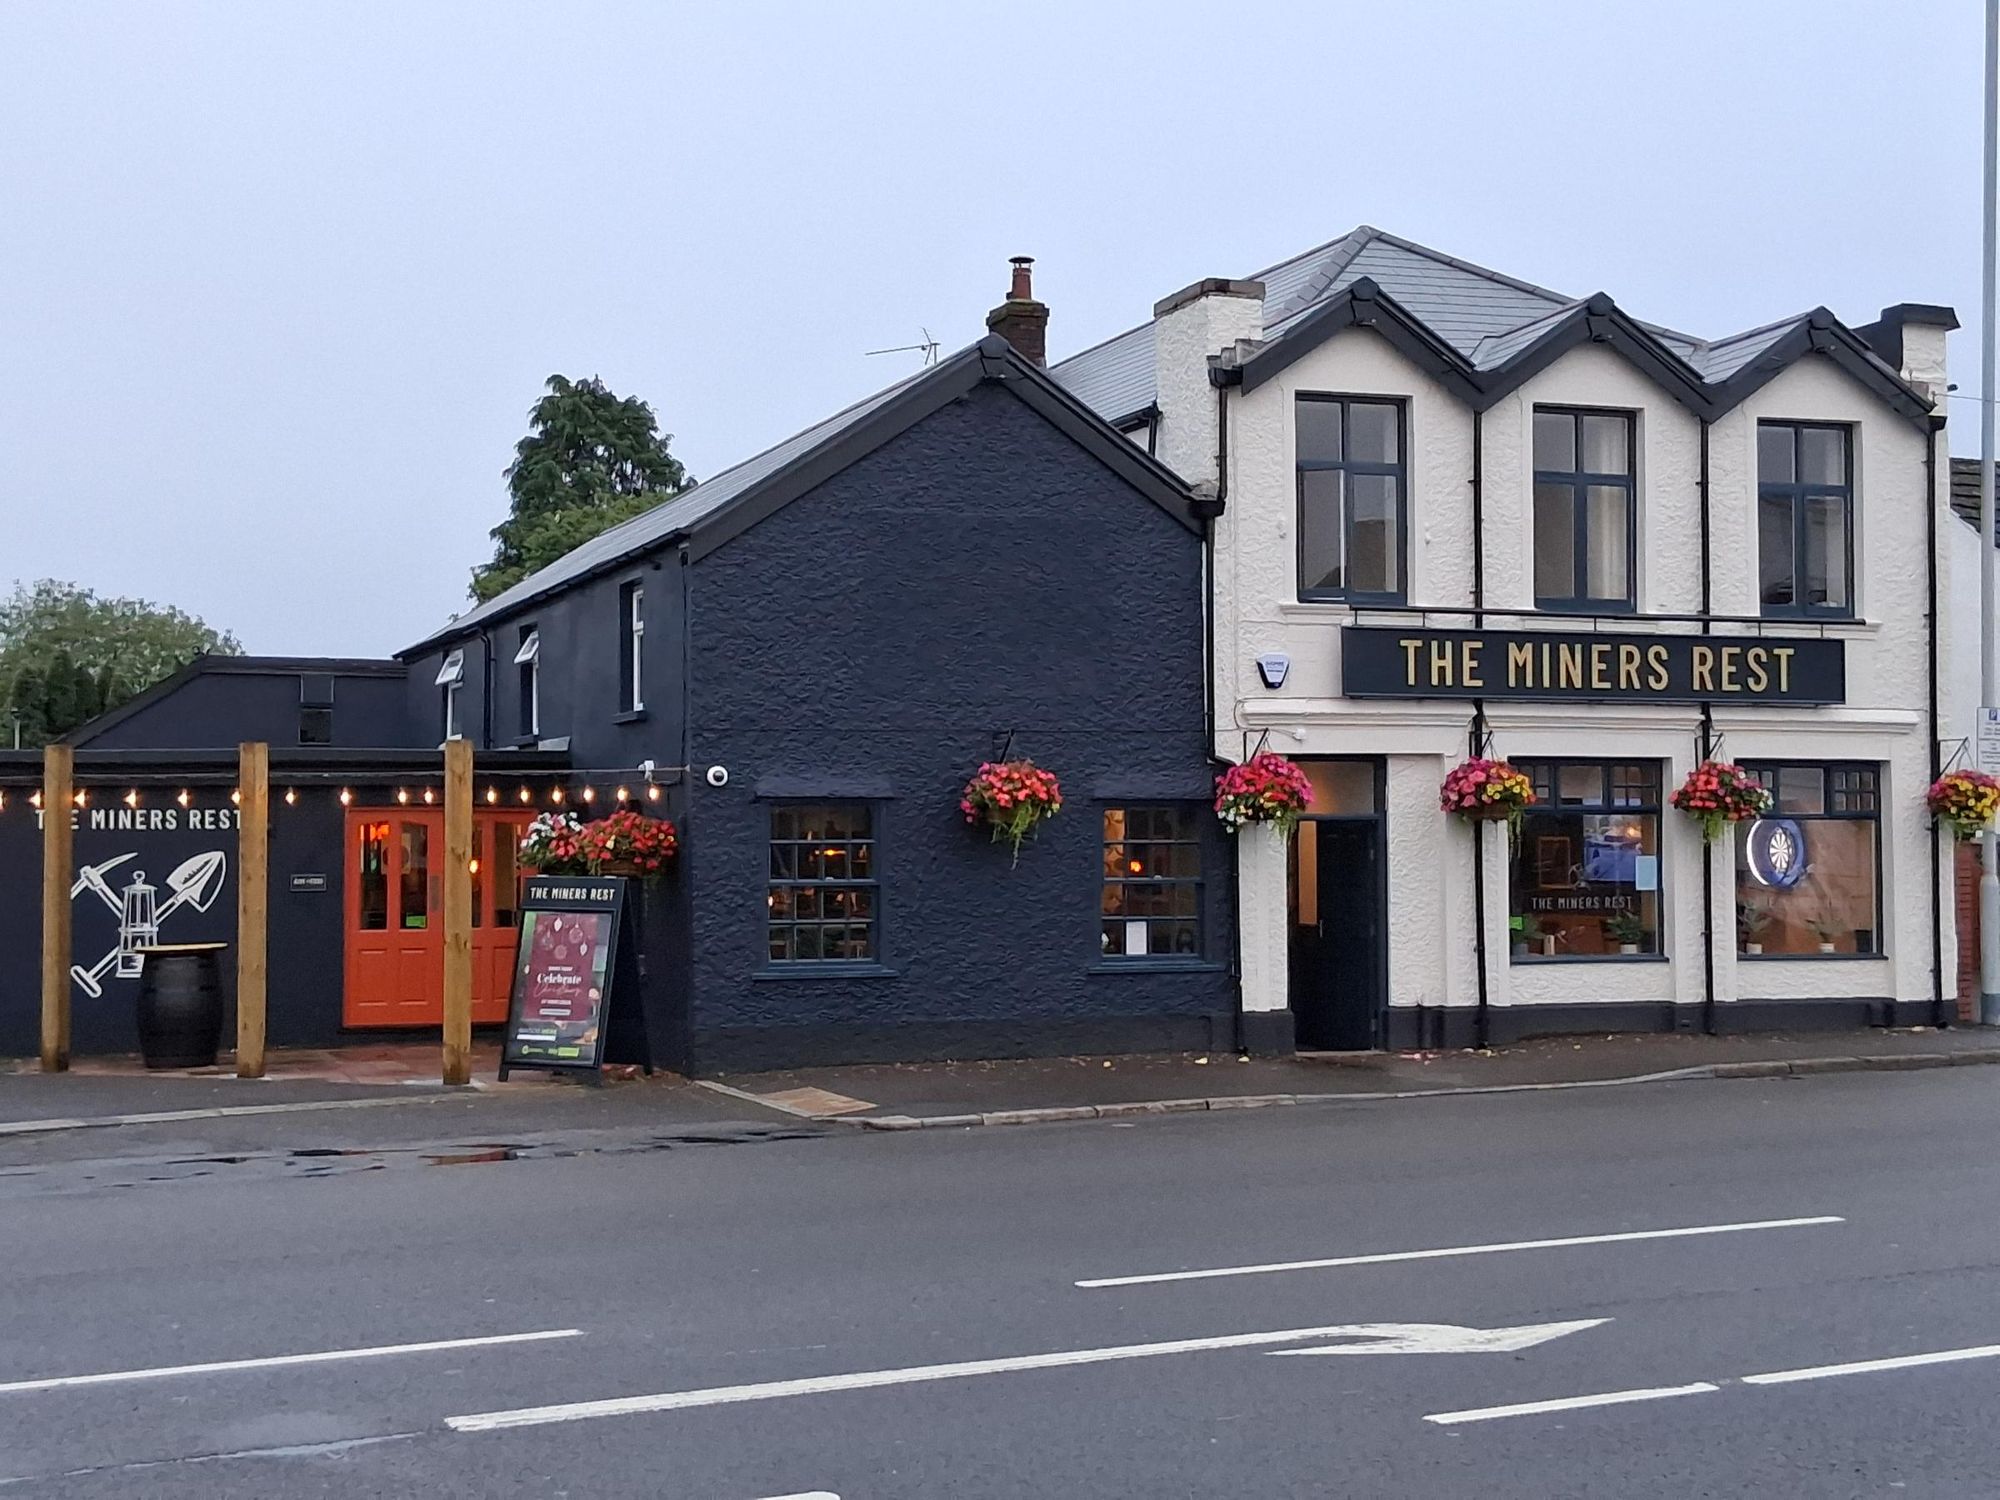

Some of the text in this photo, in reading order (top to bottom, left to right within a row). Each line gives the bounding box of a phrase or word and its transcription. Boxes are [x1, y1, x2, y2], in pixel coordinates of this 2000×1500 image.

[1400, 640, 1794, 692] THE MINERS REST
[35, 809, 240, 830] TE MINERS REST
[530, 887, 615, 901] THE MINERS REST
[1531, 896, 1633, 909] THE MINERS REST
[537, 973, 582, 985] Celebrate
